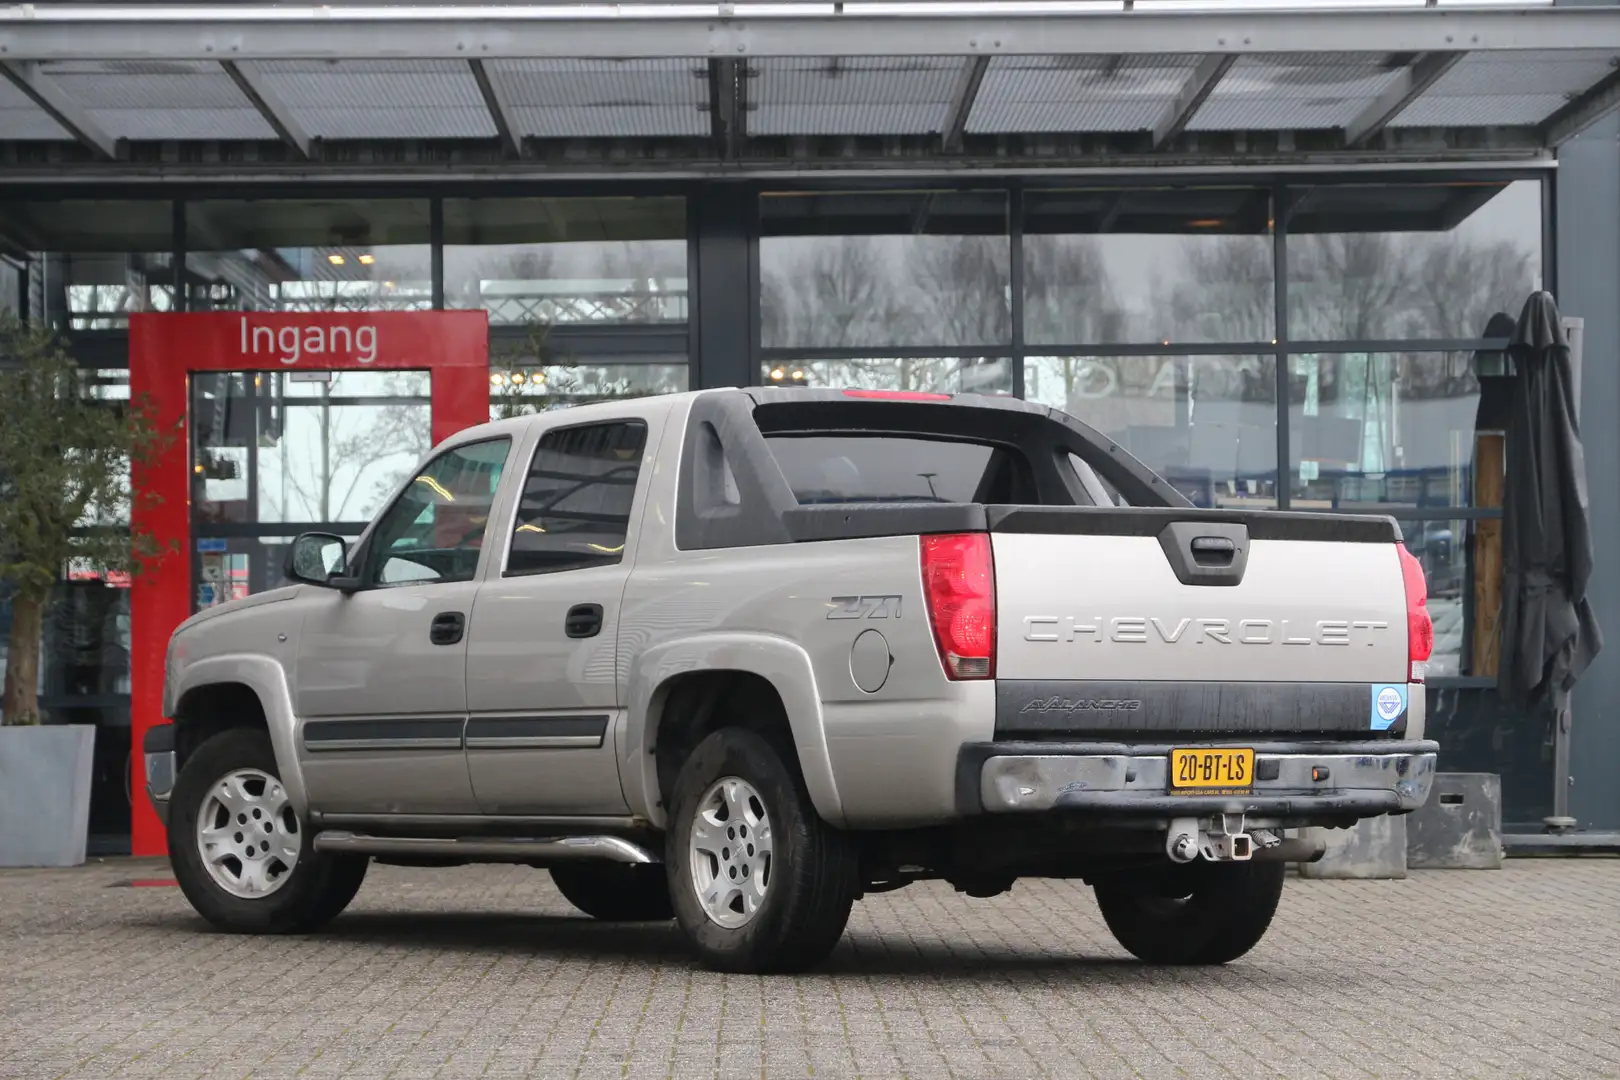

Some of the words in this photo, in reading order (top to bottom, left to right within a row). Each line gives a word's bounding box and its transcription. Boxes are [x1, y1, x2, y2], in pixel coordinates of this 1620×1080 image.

[240, 316, 377, 364] Ingang
[826, 594, 903, 620] Z71
[1023, 614, 1388, 647] CHEVROLET
[1019, 695, 1142, 714] AVALANCHE
[1179, 754, 1245, 781] 20-BT-LS
